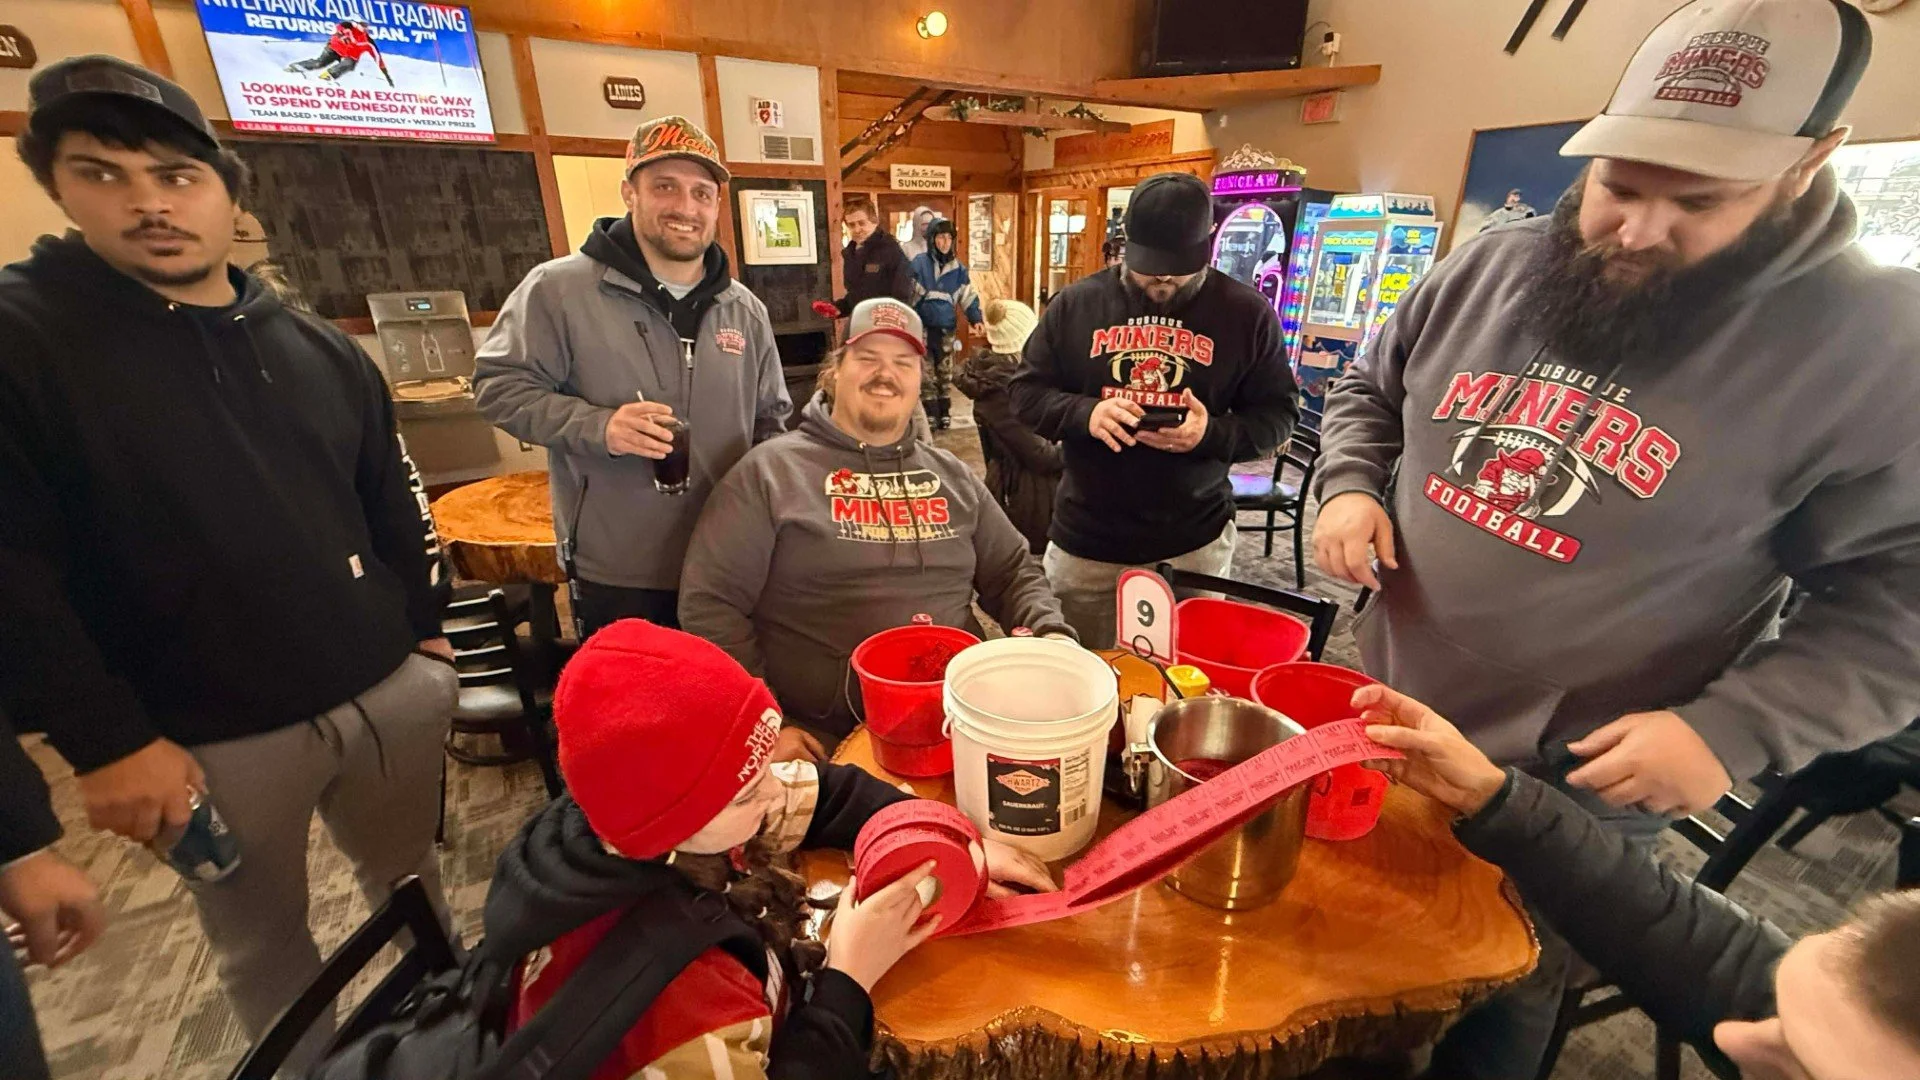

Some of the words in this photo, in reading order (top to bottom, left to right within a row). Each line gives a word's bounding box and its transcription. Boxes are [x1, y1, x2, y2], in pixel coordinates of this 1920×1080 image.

[204, 0, 323, 18] HAWK
[325, 0, 388, 25] ADULT
[390, 2, 467, 33] RACING
[244, 12, 338, 35] RETURNS
[367, 25, 410, 43] JAN.
[410, 29, 437, 44] 7TH
[1688, 32, 1770, 55] DUBUQUE
[1655, 46, 1771, 89] MINERS
[240, 81, 313, 97] LOOKING
[315, 86, 347, 99] FOR
[349, 89, 371, 101] AN
[373, 91, 438, 105] EXCITING
[440, 95, 472, 107] WAY
[607, 83, 642, 102] LADIES
[758, 101, 771, 109] AED
[1658, 87, 1735, 105] FOOTBALL
[243, 94, 267, 106] TO
[269, 96, 322, 109] SPEND
[324, 100, 418, 115] WEDNESDAY
[420, 106, 476, 119] NIGHTS?
[250, 108, 279, 118] TEAM
[280, 111, 312, 120] BASED
[319, 113, 365, 123] BEGINNER
[365, 115, 406, 125] FRIENDLY
[412, 118, 447, 127] WEEKLY
[448, 120, 477, 128] PRIZES
[898, 179, 946, 189] SUNDOWN
[1127, 315, 1184, 329] DUBUQUE
[1089, 323, 1215, 367] MINERS
[1103, 387, 1187, 408] FOOTBALL
[1431, 370, 1681, 500] MINERS
[830, 496, 951, 527] MINERS
[1426, 477, 1567, 560] FOOTBALL
[1136, 599, 1155, 628] 9
[744, 720, 765, 750] THE
[1002, 800, 1045, 809] SAUERKRAUT
